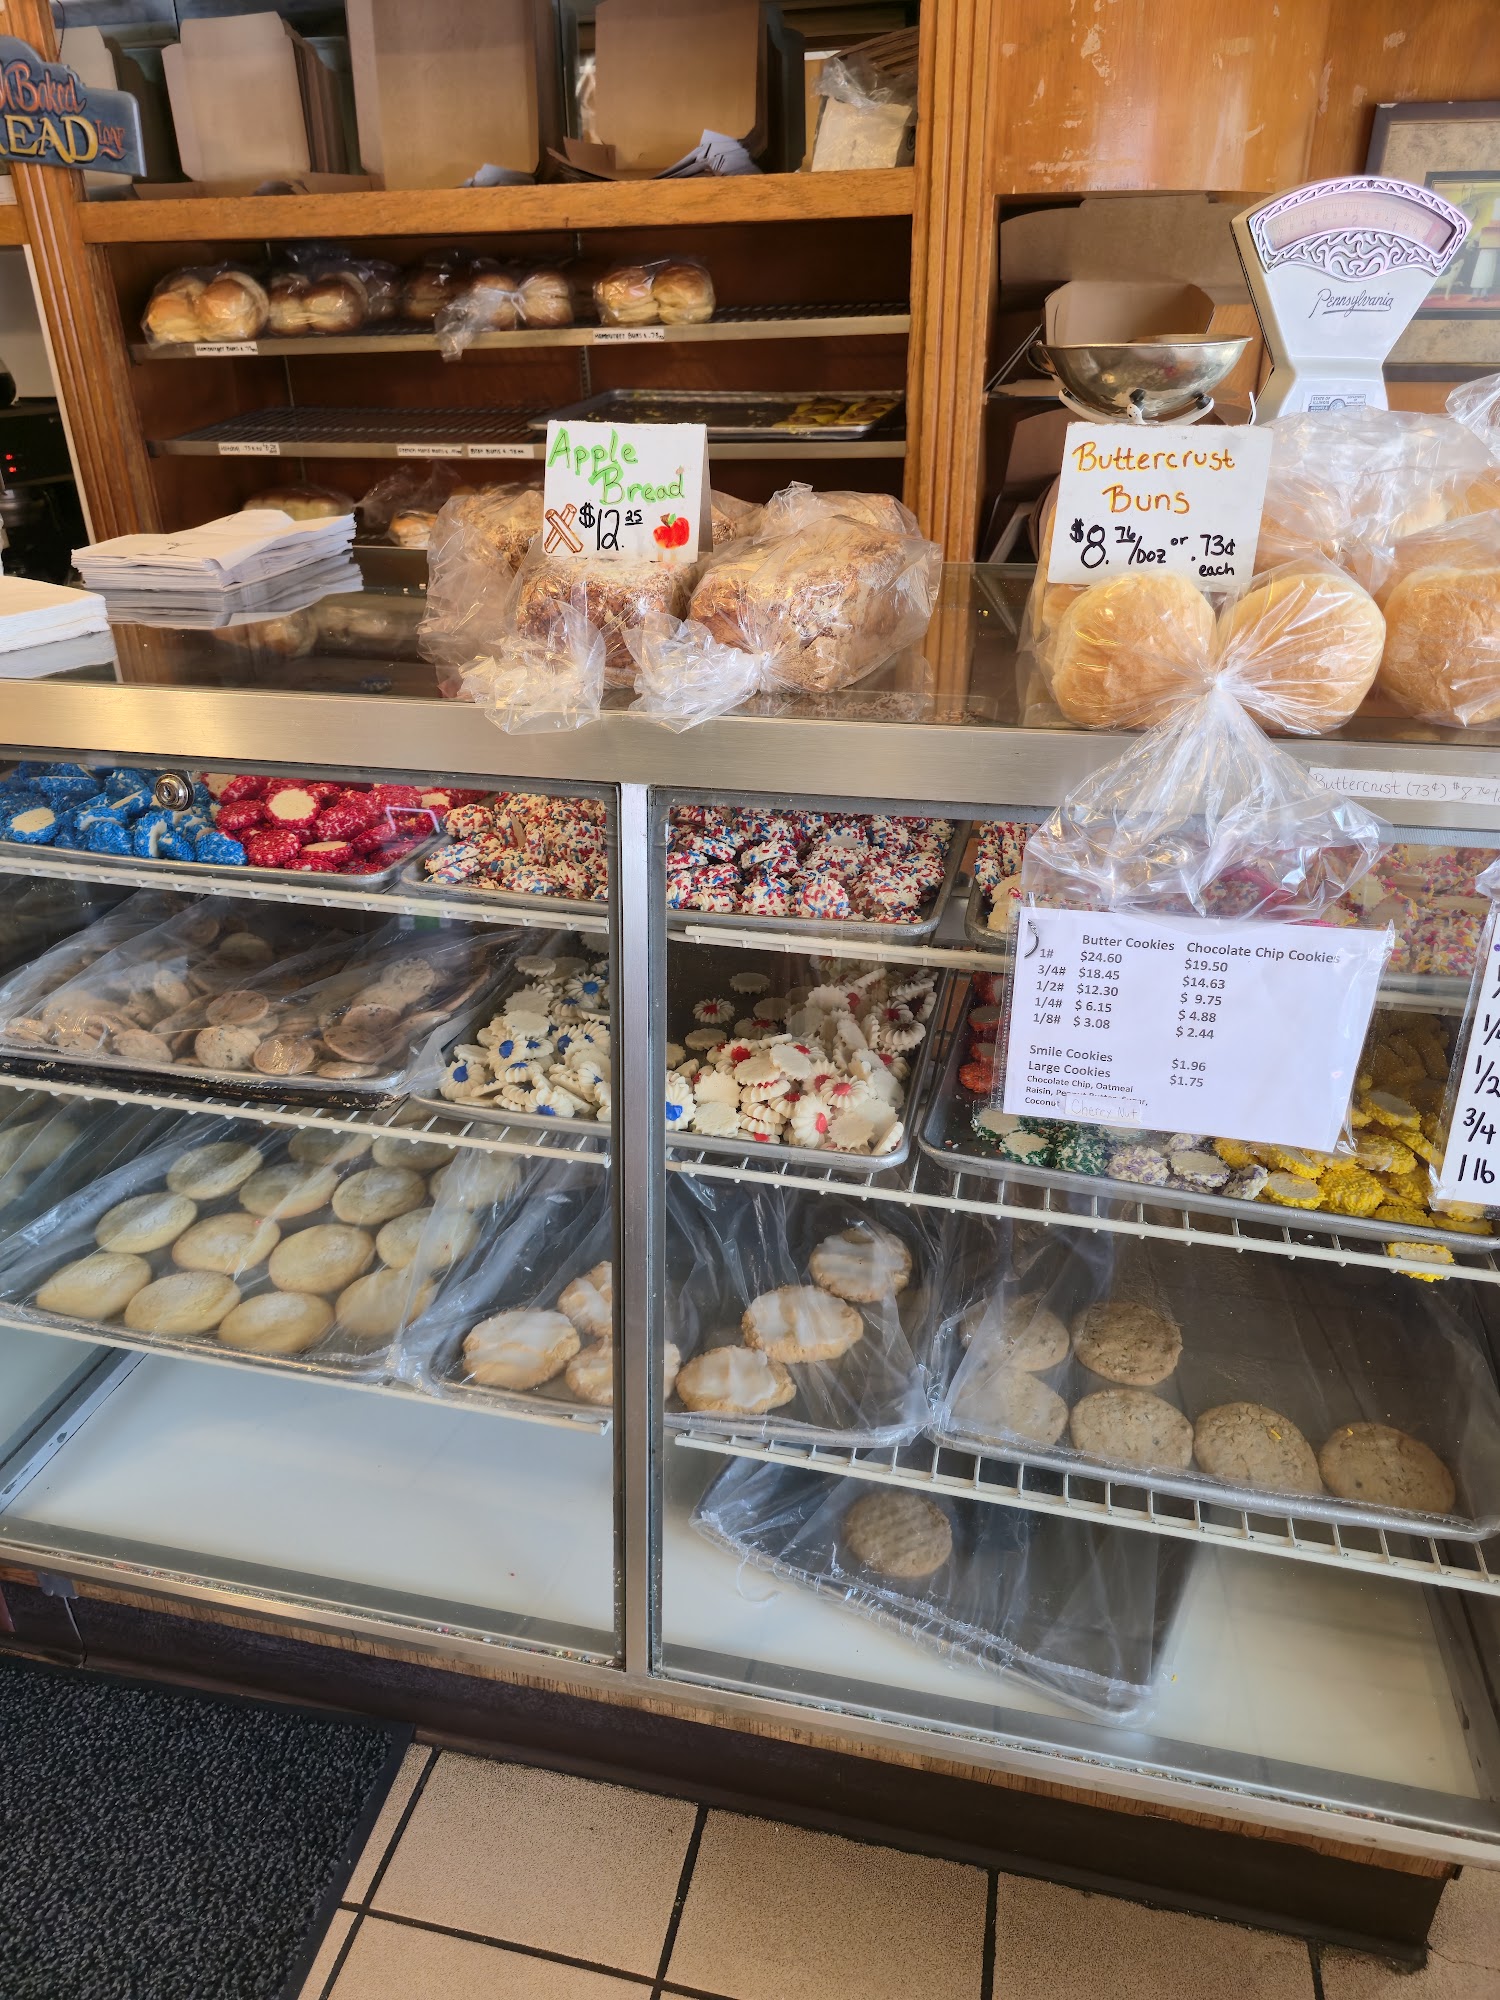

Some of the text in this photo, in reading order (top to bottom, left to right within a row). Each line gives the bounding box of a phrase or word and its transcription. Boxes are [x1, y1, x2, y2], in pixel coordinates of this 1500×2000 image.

[5, 62, 87, 113] Baked
[0, 115, 98, 163] EAD
[1308, 288, 1394, 318] Pennsylvania
[547, 428, 638, 475] Apple
[1072, 441, 1235, 472] Buttercrust
[588, 463, 685, 505] Bread
[1102, 484, 1190, 514] Buns
[1170, 536, 1188, 547] or
[1199, 563, 1235, 577] each
[1082, 934, 1175, 951] Butter Cookies
[1186, 942, 1341, 964] Chocolate Chip Cookies
[1039, 948, 1228, 972] 1# $24.60 $19.50
[1037, 964, 1226, 989] 3/4# $18.45 $14.63
[1034, 996, 1063, 1008] 1/4#
[1036, 980, 1064, 992] 1/2#
[1076, 983, 1119, 996] $12.30
[1194, 994, 1222, 1006] 9.75
[1033, 1012, 1061, 1024] 1/8#
[1029, 1044, 1206, 1072] Smile Cookies $1.96
[1027, 1075, 1070, 1086] Chocolate
[1071, 1080, 1093, 1089] Chip,
[1095, 1082, 1134, 1093] Oatmeal
[1028, 1060, 1204, 1087] Large Cookies $1.75
[1024, 1096, 1060, 1107] Coconut
[1025, 1086, 1053, 1096] Raisin,
[1117, 1106, 1138, 1119] Nut
[1463, 1107, 1497, 1145] 3/4
